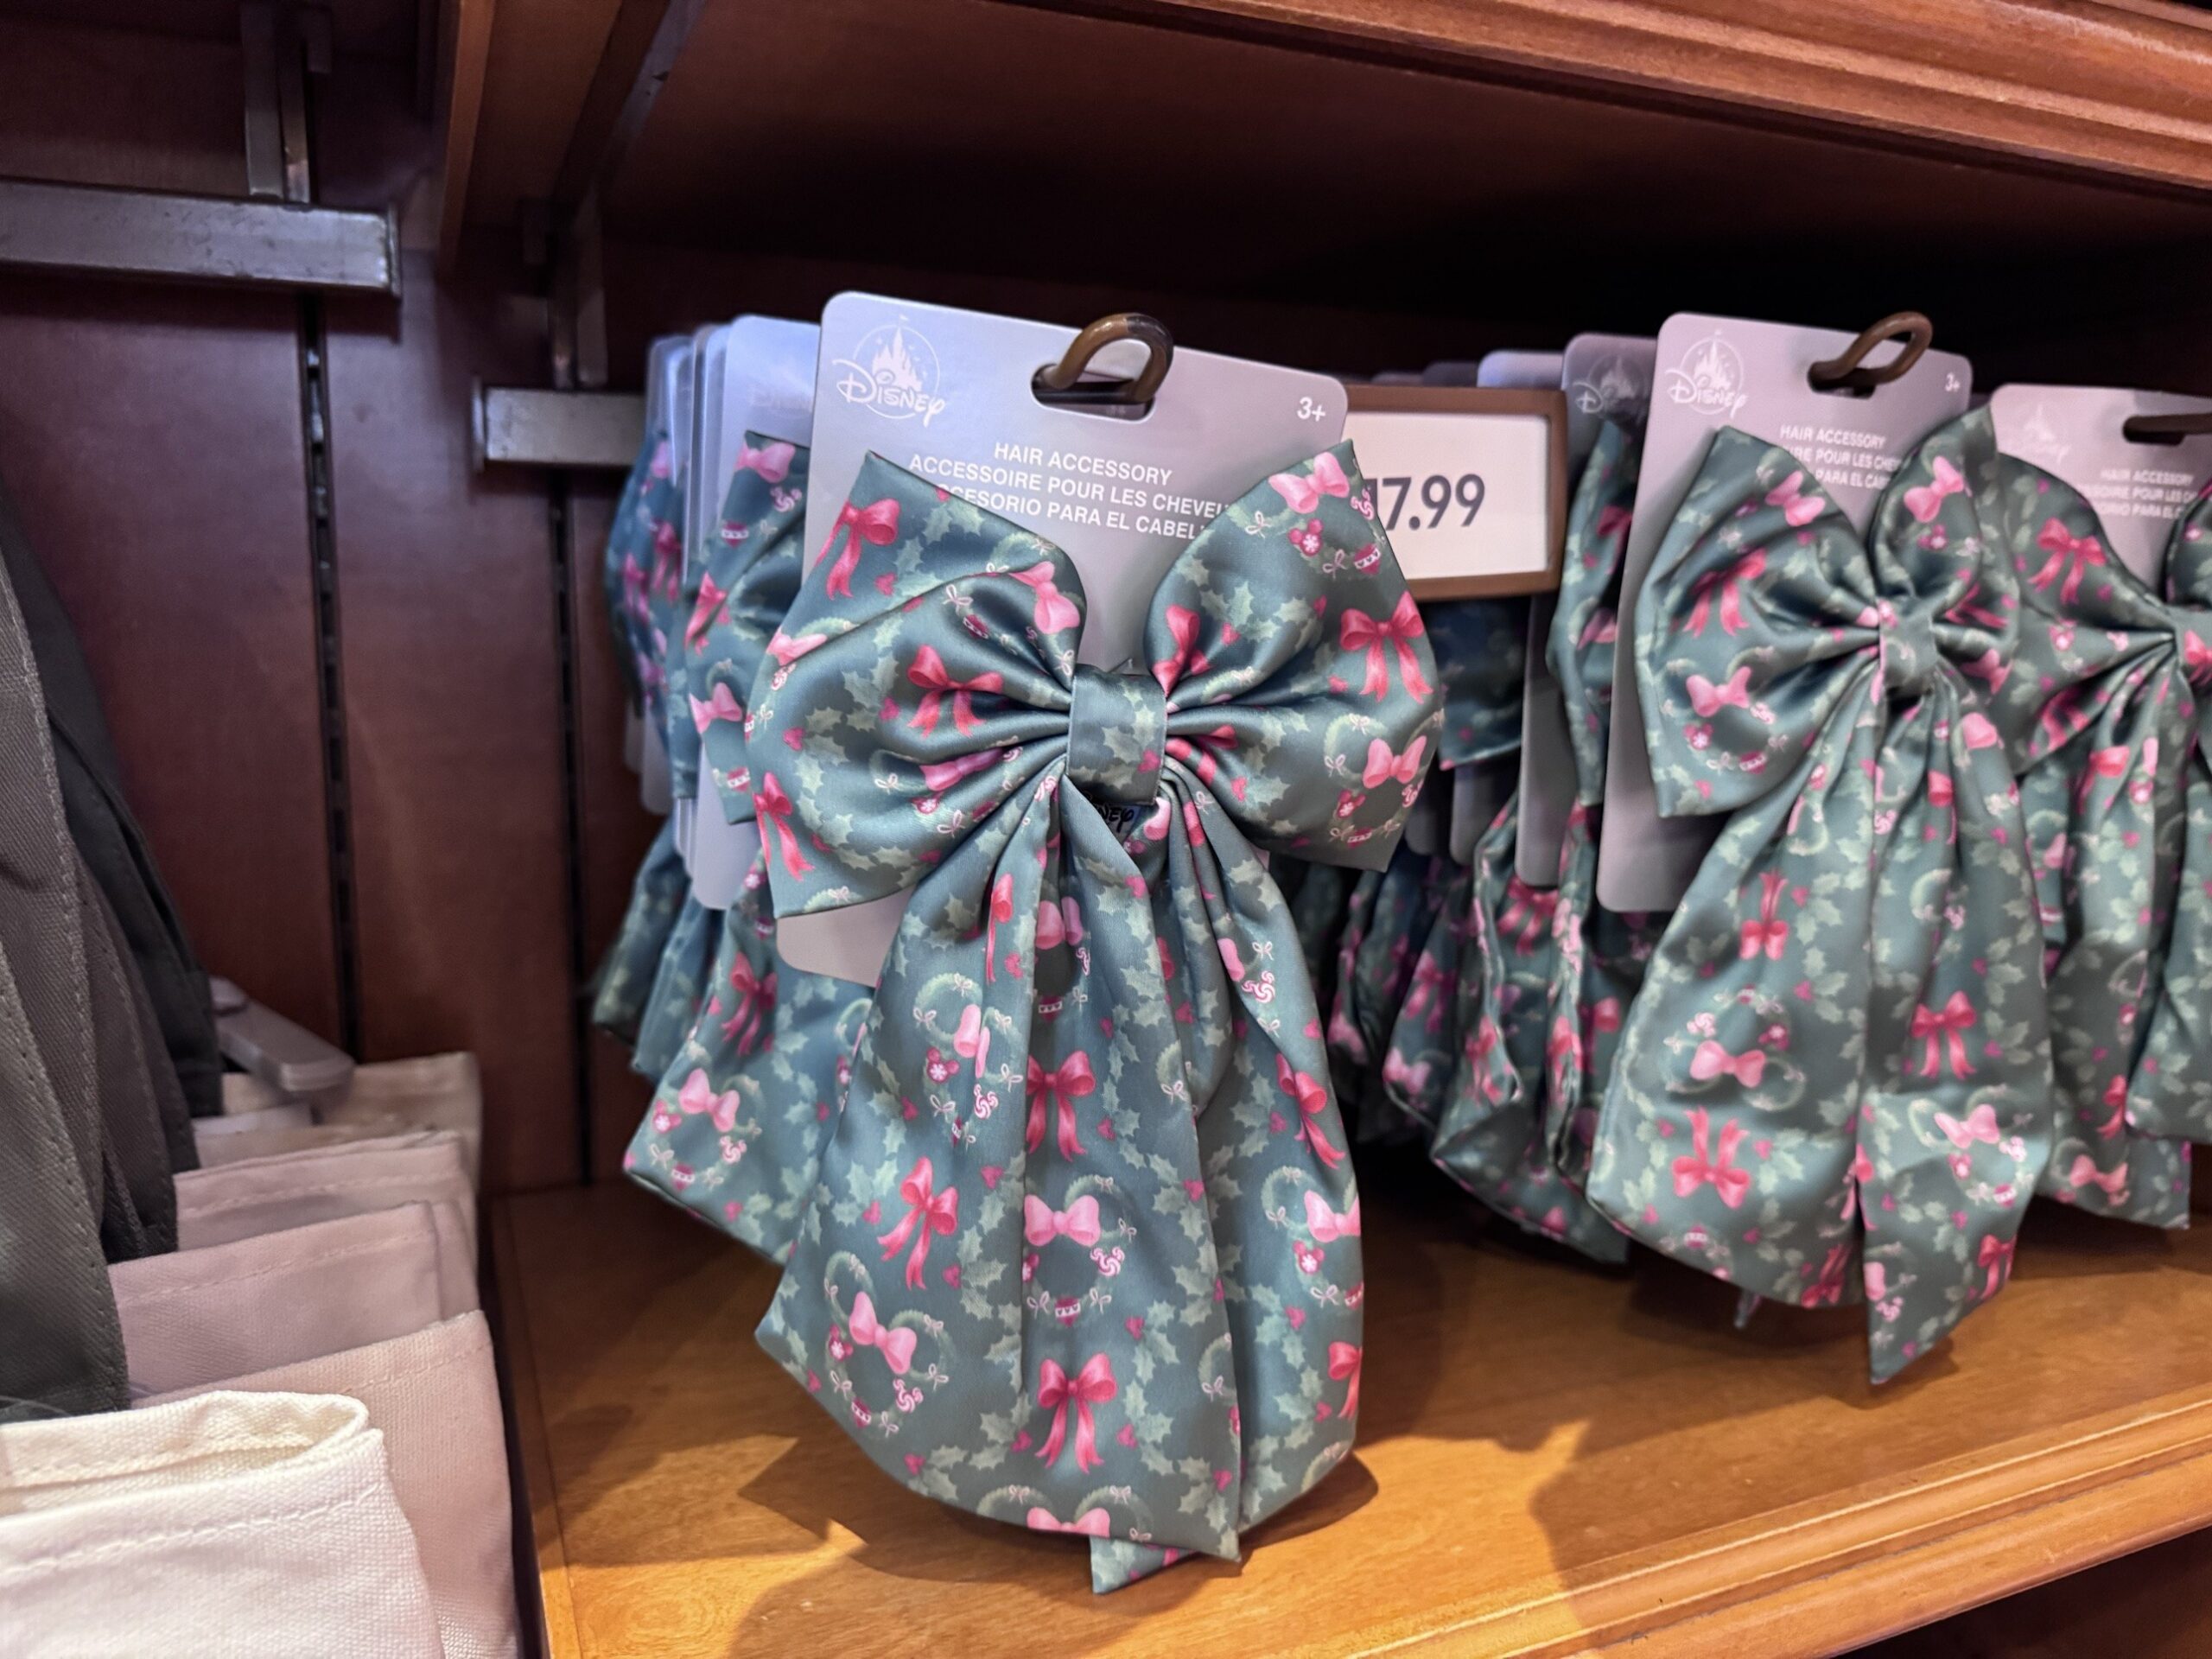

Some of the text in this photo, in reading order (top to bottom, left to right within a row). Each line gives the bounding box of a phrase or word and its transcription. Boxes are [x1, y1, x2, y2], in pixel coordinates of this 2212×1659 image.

[1297, 397, 1325, 421] 3+
[1779, 425, 1886, 448] HAIR ACCESSORY
[994, 442, 1173, 486] HAIR ACCESSORY
[1815, 448, 1851, 467] POUR
[1852, 454, 1872, 469] LES
[909, 454, 1043, 491] ACCESSOIRE
[1047, 476, 1104, 501] POUR
[1110, 486, 1147, 508] LES
[1046, 502, 1101, 526] PARA
[1106, 512, 1130, 531] EL
[1135, 516, 1205, 540] CABEL
